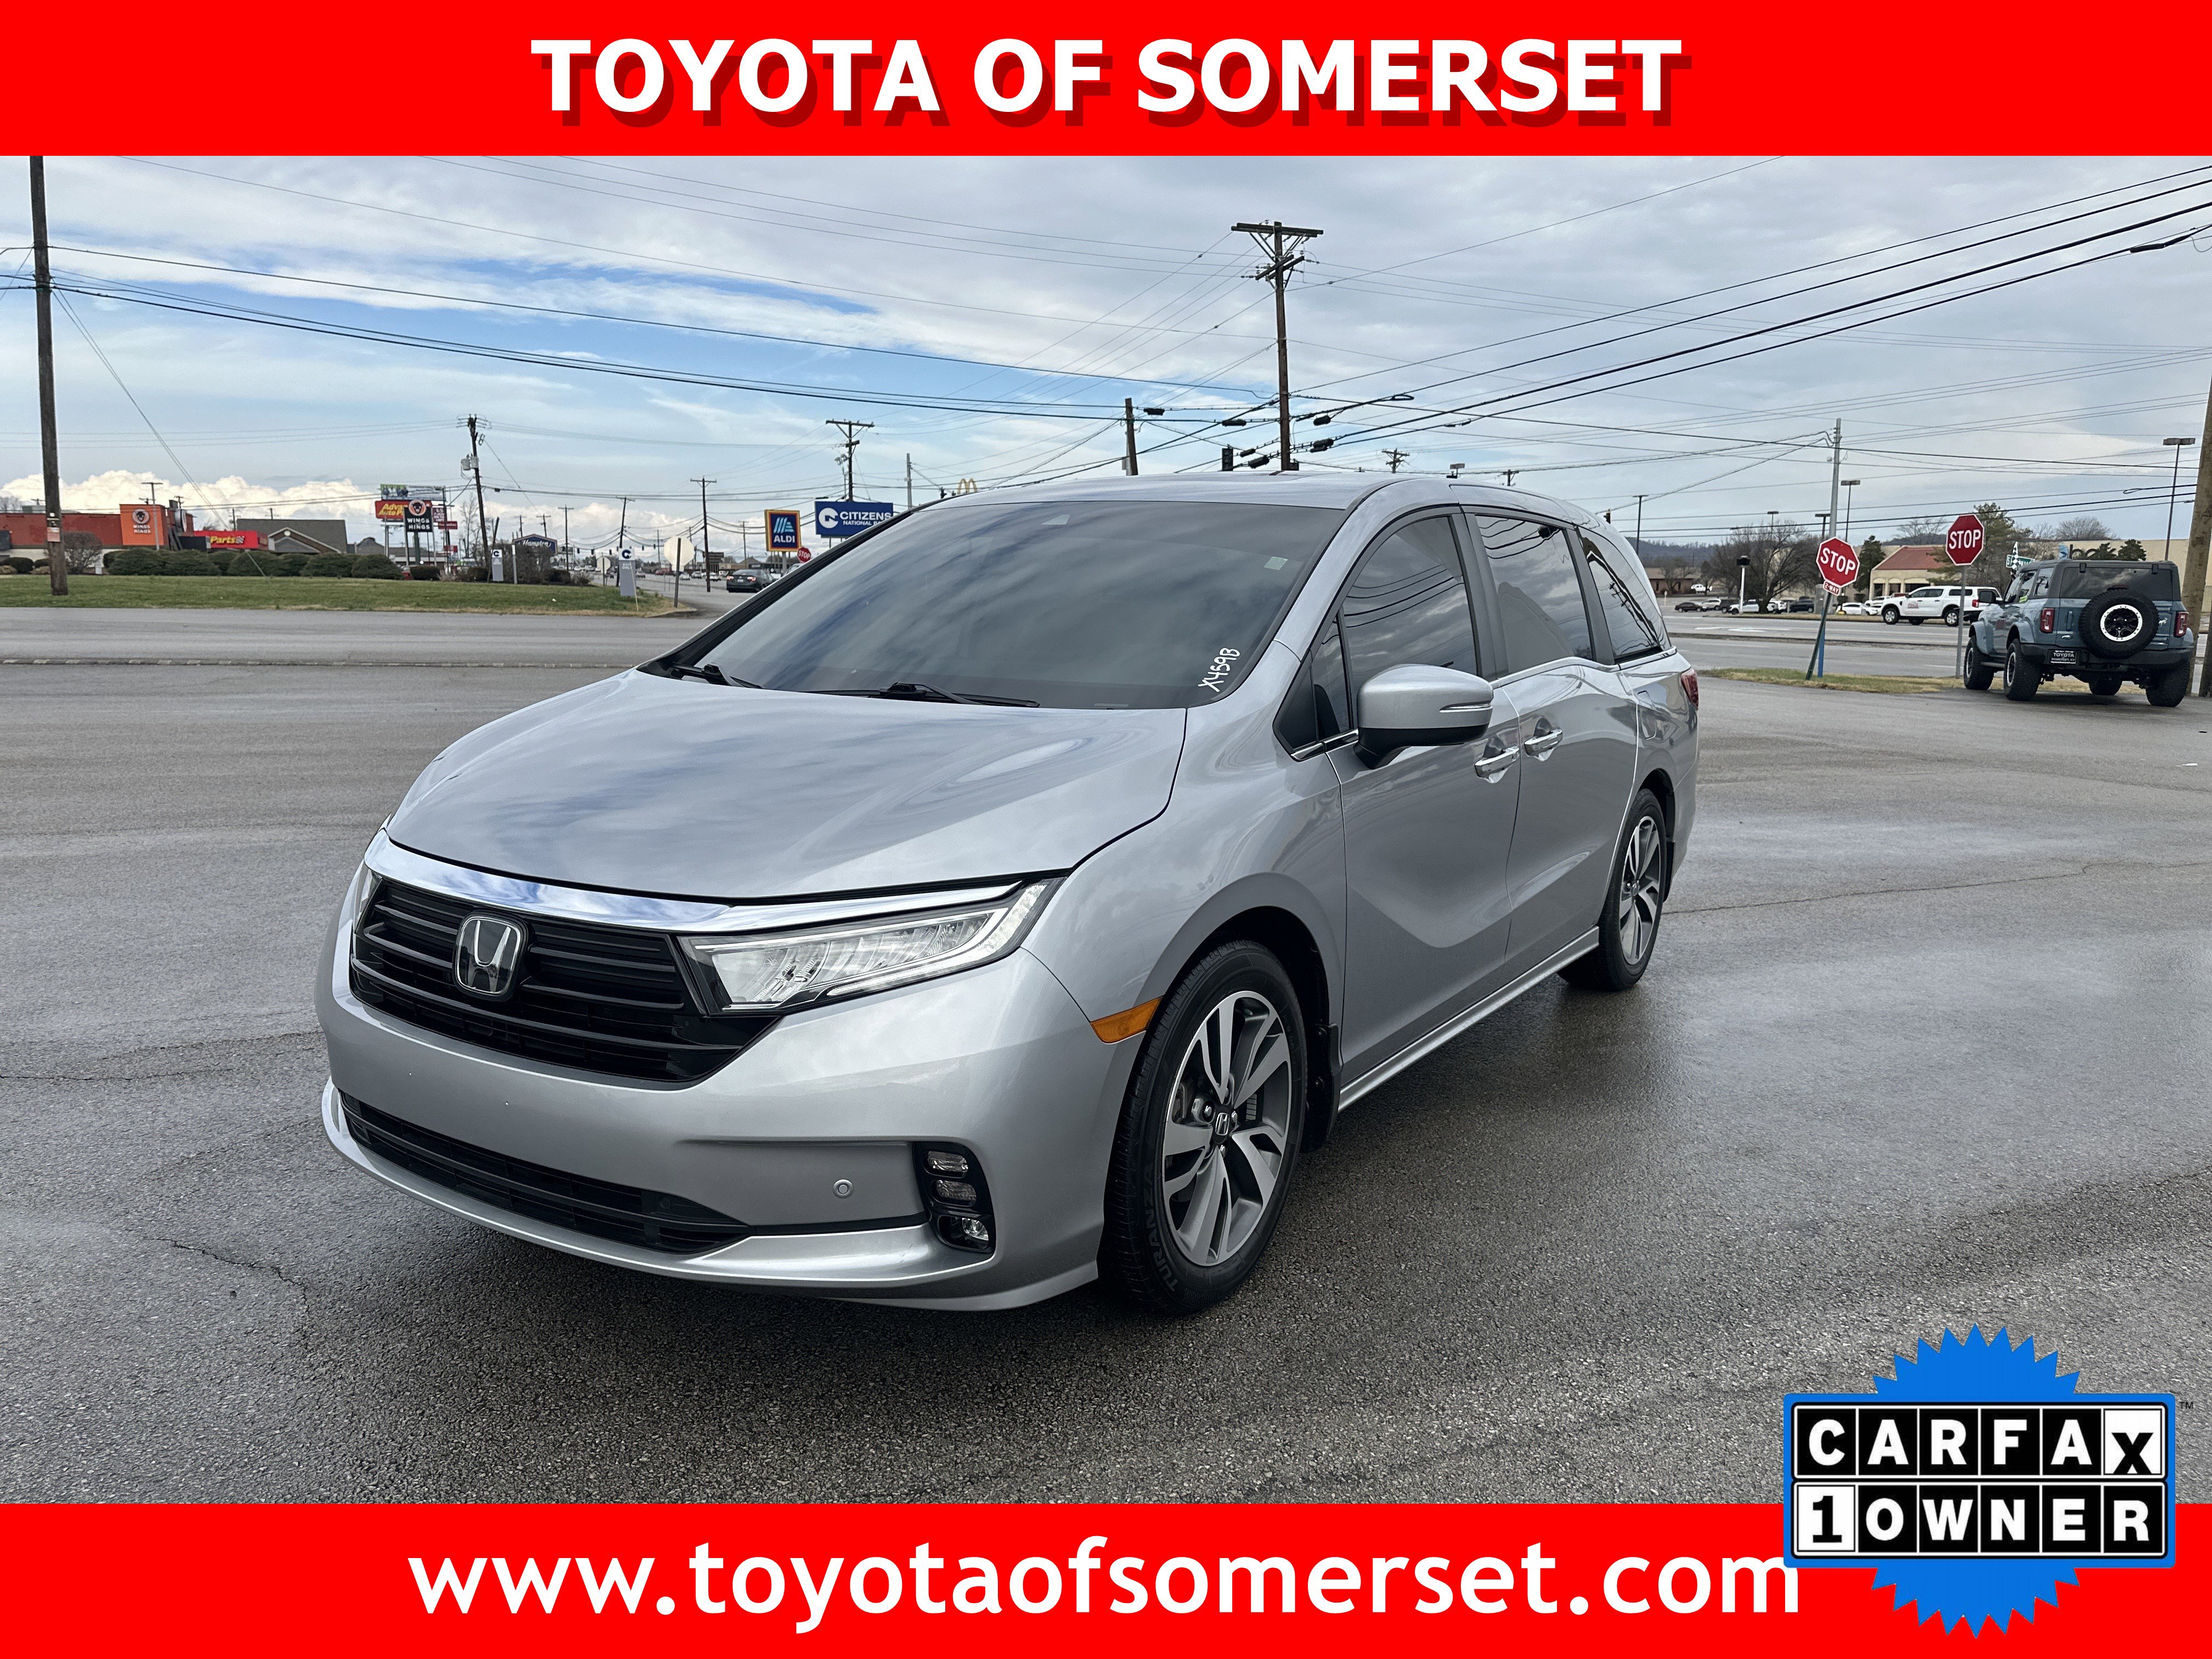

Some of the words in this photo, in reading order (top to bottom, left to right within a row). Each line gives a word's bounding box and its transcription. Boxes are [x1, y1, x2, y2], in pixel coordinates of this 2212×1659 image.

[839, 511, 891, 521] CITIZENS
[774, 535, 795, 543] ALDI
[1949, 529, 1981, 549] STOP
[798, 549, 810, 560] STOP
[1820, 548, 1855, 575] STOP
[1825, 583, 1839, 593] 2-WAY
[1198, 647, 1240, 692] X459B
